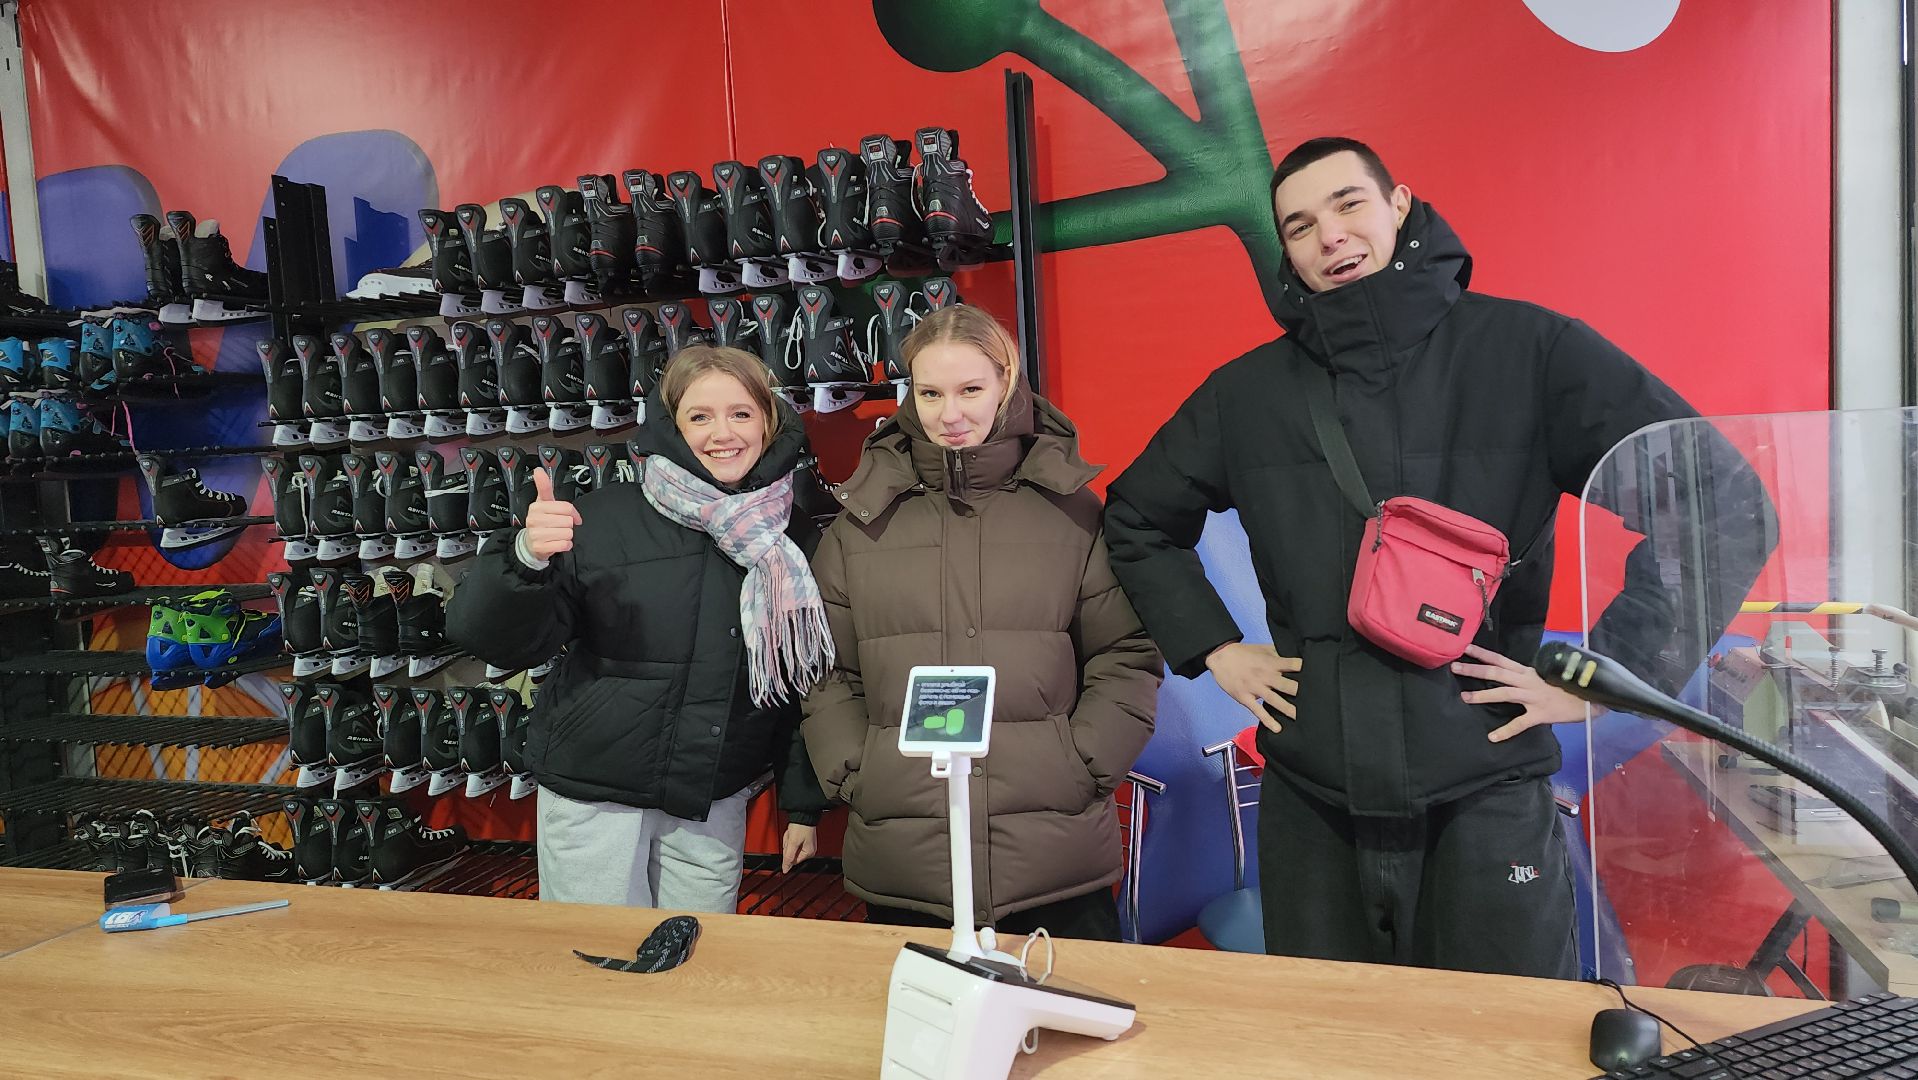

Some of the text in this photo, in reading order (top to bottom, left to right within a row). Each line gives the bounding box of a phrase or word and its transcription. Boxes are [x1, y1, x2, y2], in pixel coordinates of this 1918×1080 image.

[752, 227, 773, 241] RENTAL
[830, 351, 849, 364] RENTAL
[566, 372, 584, 385] RENTA
[490, 503, 510, 513] RENTA
